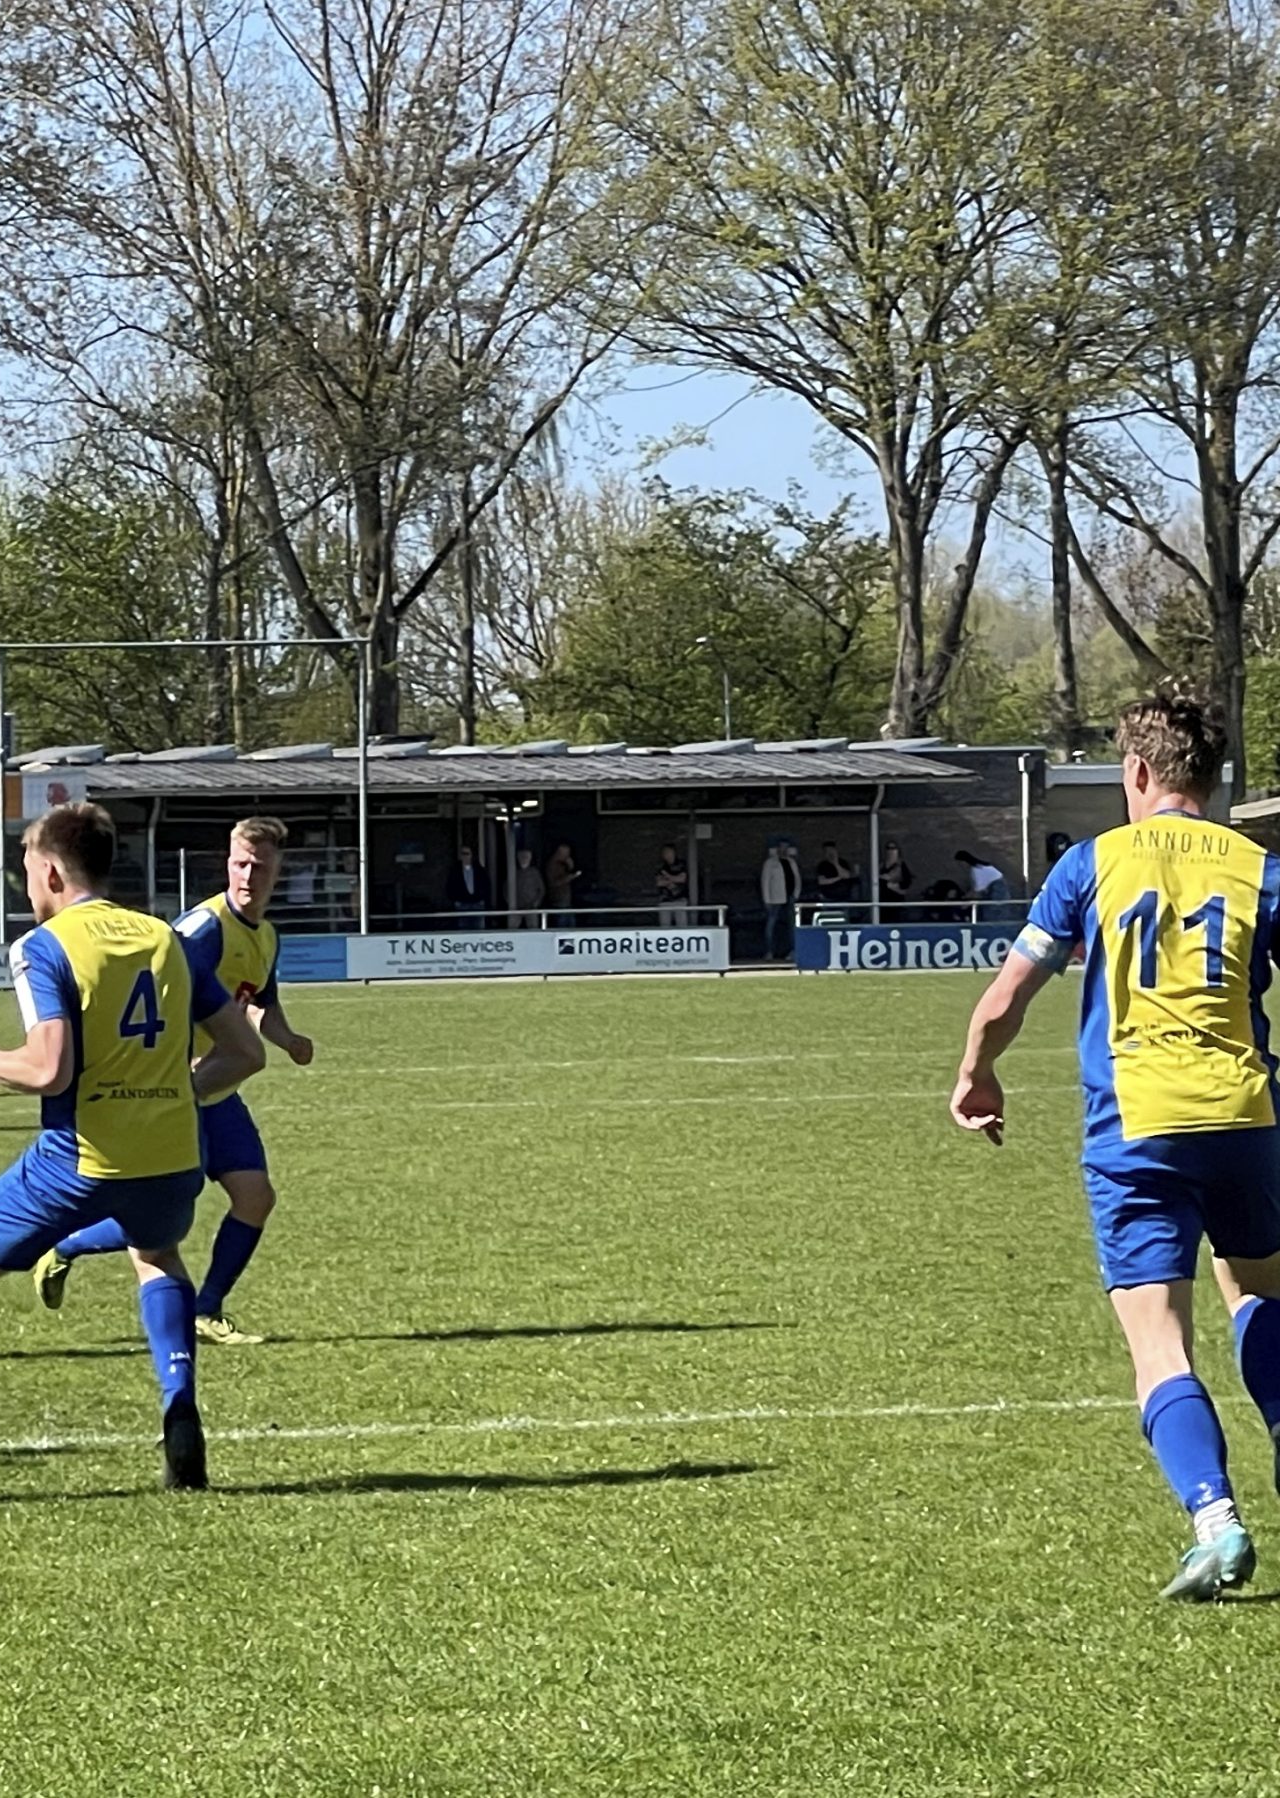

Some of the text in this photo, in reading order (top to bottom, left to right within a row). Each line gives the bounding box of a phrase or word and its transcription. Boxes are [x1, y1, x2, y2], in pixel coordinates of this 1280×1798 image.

[1133, 829, 1230, 856] ANNO NU
[440, 938, 514, 954] Services
[828, 930, 1014, 969] Heineke
[1120, 890, 1225, 988] 11
[120, 969, 165, 1048] 4
